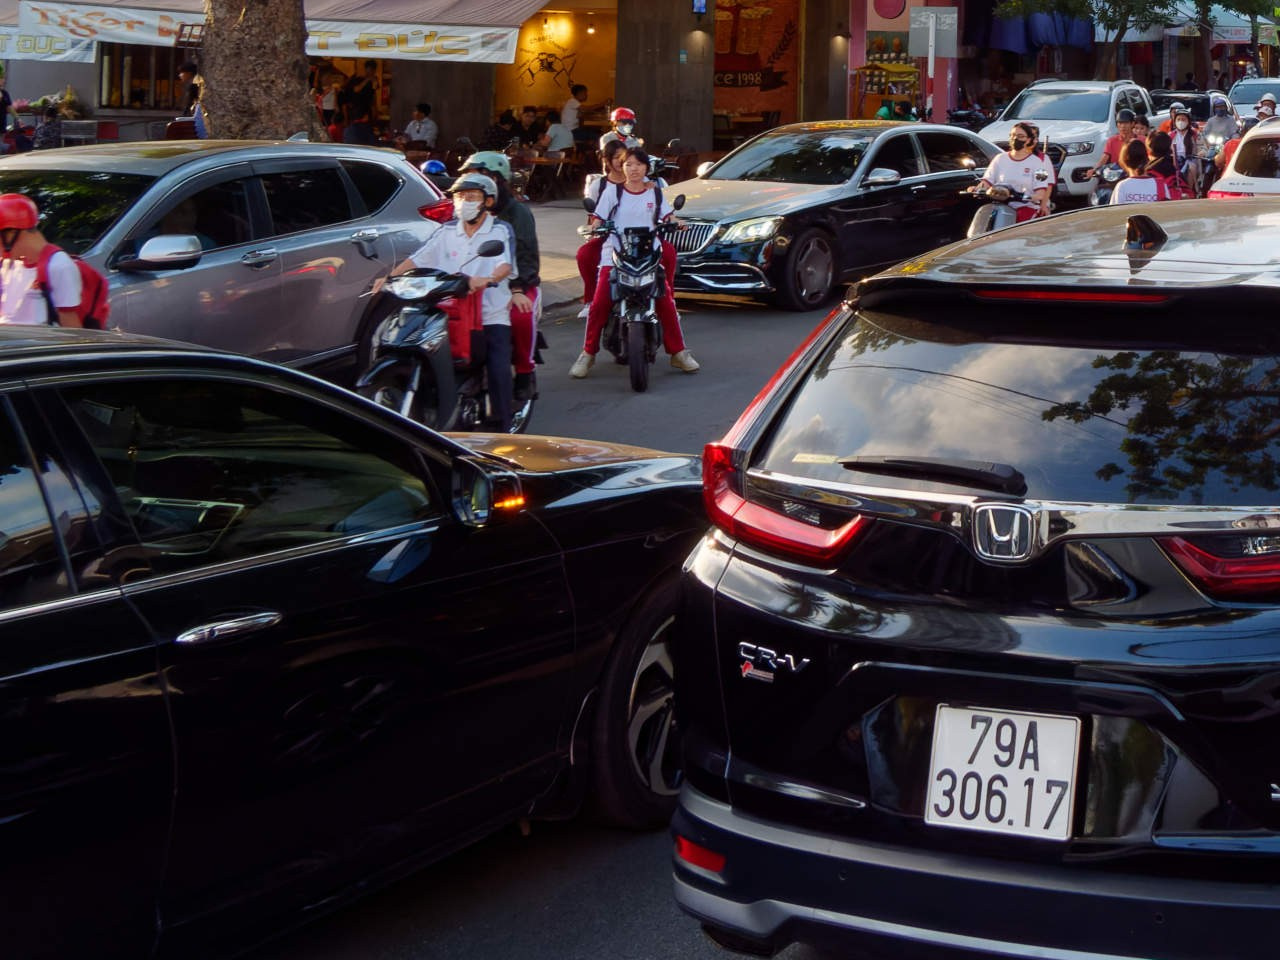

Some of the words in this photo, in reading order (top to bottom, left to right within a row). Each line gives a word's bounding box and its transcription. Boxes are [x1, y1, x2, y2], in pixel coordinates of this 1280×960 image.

[354, 29, 471, 55] ĐỨC
[738, 72, 762, 86] 1998
[739, 642, 811, 672] CR-V
[967, 714, 1040, 772] 79A
[934, 768, 1069, 830] 306.17
